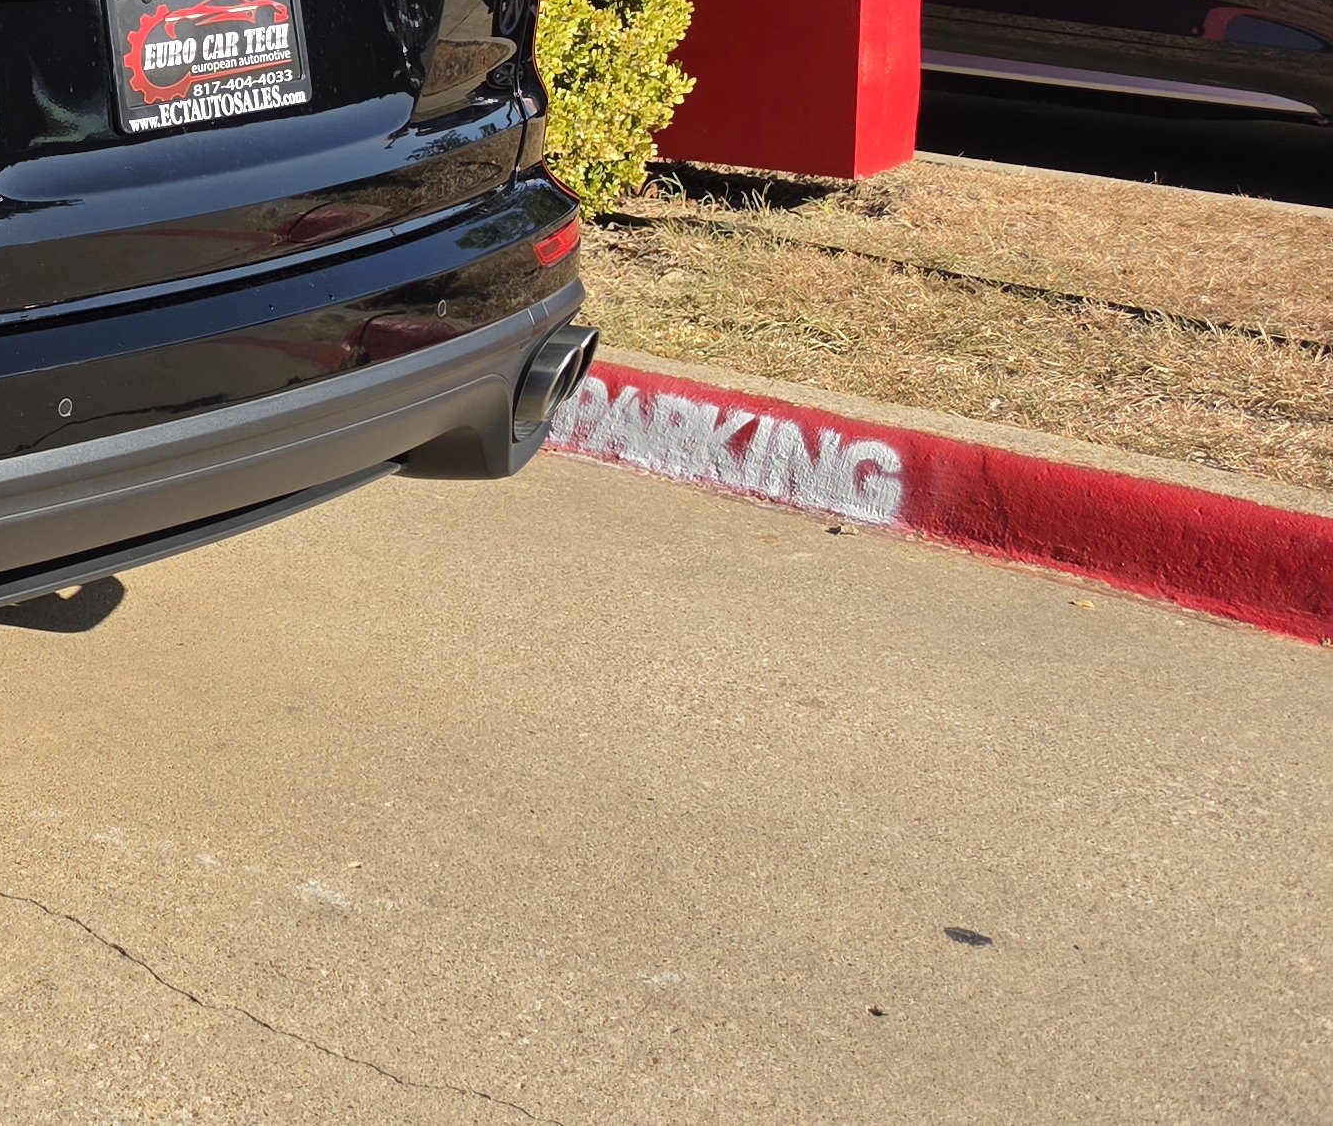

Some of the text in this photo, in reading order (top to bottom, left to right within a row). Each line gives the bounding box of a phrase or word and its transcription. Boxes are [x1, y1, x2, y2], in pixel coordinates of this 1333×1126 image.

[143, 23, 290, 71] EURO CAR TECH
[191, 49, 292, 74] european automotive
[192, 69, 293, 97] 817-404-4033
[129, 84, 306, 133] www.ECTAUTOSALES.com
[548, 376, 906, 527] PARKING
